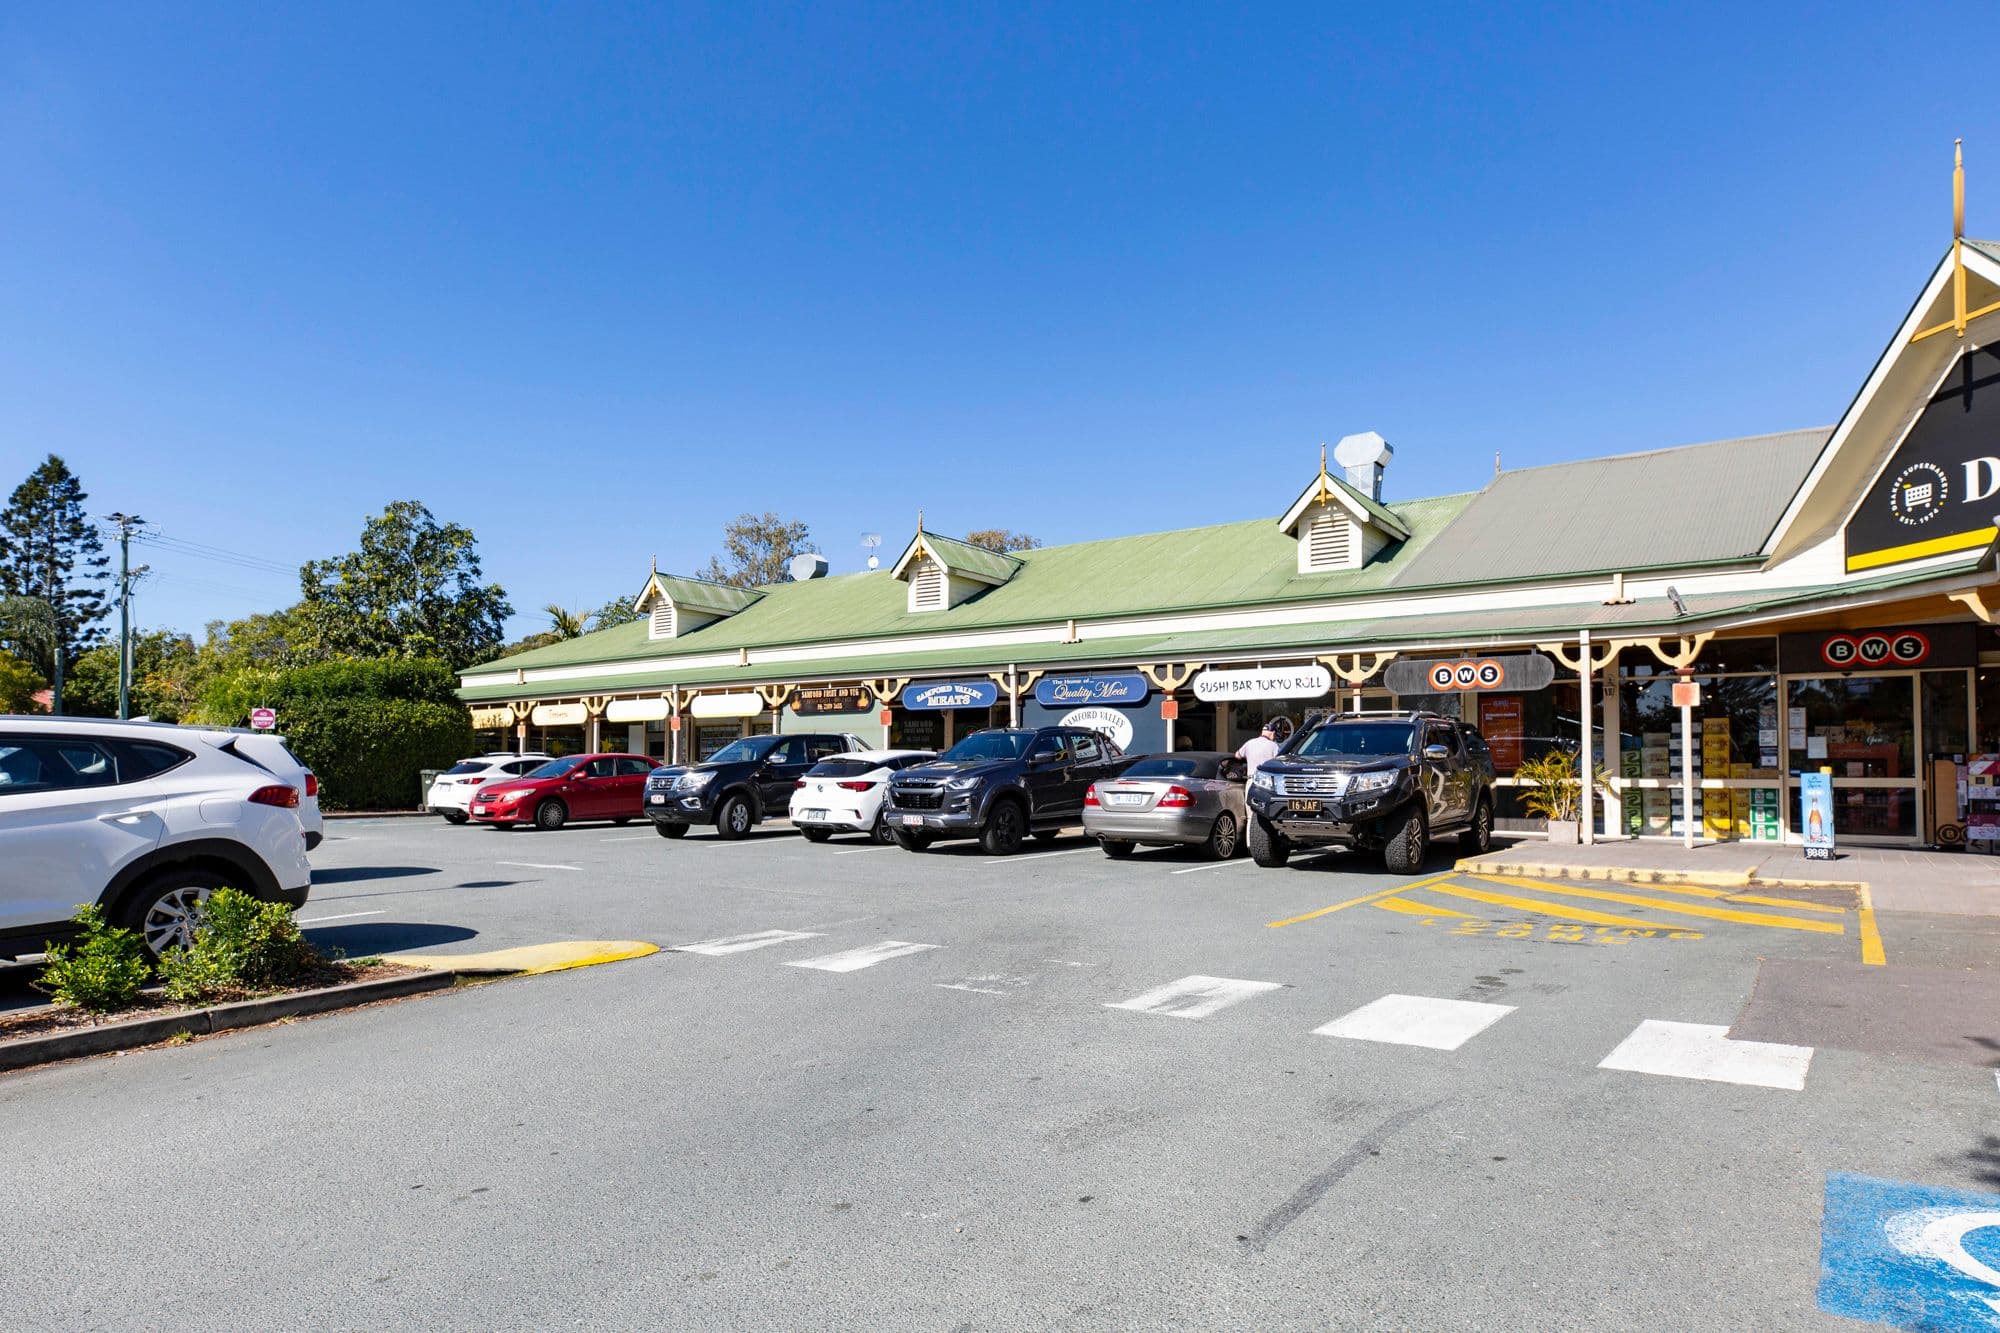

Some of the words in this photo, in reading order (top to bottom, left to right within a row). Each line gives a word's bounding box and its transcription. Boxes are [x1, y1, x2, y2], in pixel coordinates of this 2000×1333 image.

[1890, 477, 1903, 511] DRAKES
[1903, 463, 1948, 499] SUPERMARKETS
[1899, 515, 1917, 526] EST.
[1053, 684, 1093, 703] Quality
[1092, 681, 1128, 698] Meat
[1199, 681, 1229, 693] SUSHI
[1232, 680, 1252, 692] BAR
[1256, 679, 1292, 691] TOKYO
[1295, 677, 1322, 688] ROLL
[916, 685, 953, 703] SAMFORD
[954, 685, 983, 700] VALLEY
[927, 695, 971, 706] MEATS
[1100, 711, 1126, 728] VALLEY
[1418, 918, 1705, 940] LOADING
[1446, 928, 1633, 944] ZONE
